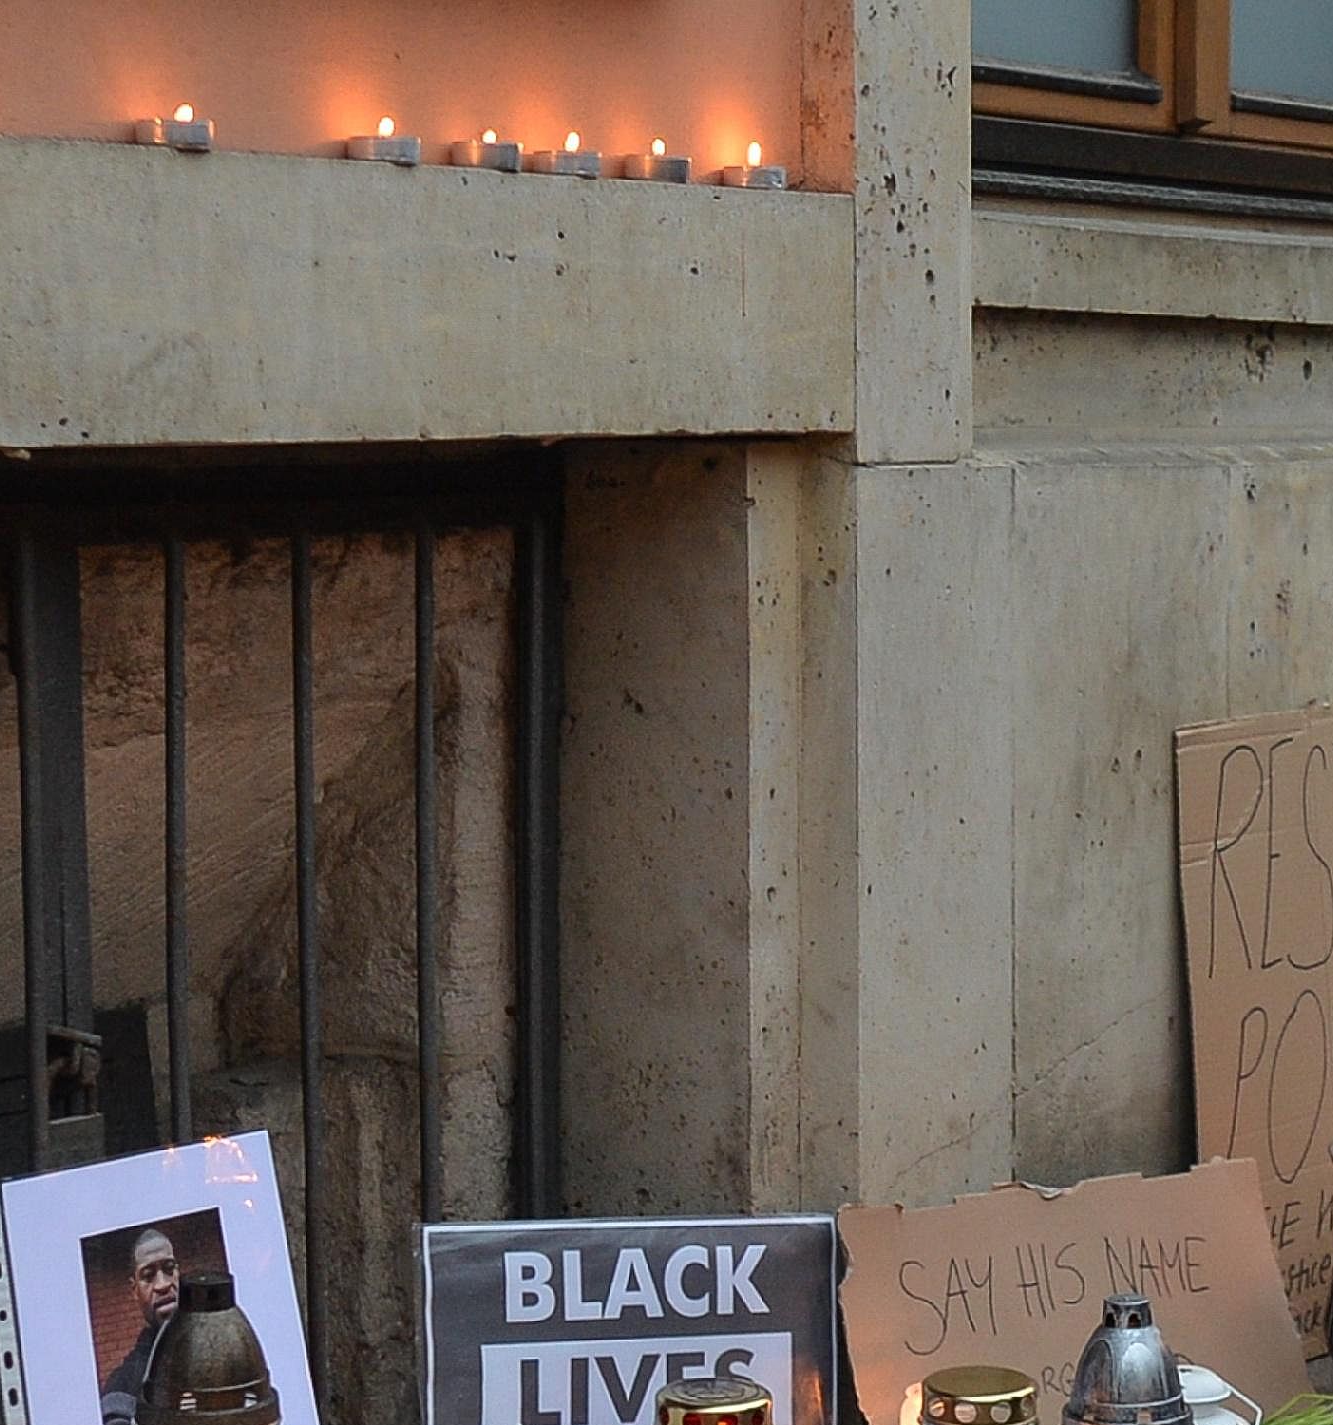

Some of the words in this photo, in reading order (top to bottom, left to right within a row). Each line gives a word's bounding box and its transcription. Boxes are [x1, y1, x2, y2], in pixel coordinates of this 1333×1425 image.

[503, 1244, 770, 1324] BLACK
[898, 1254, 997, 1356] SAY
[1016, 1241, 1086, 1319] HIS
[1103, 1235, 1211, 1299] NAME
